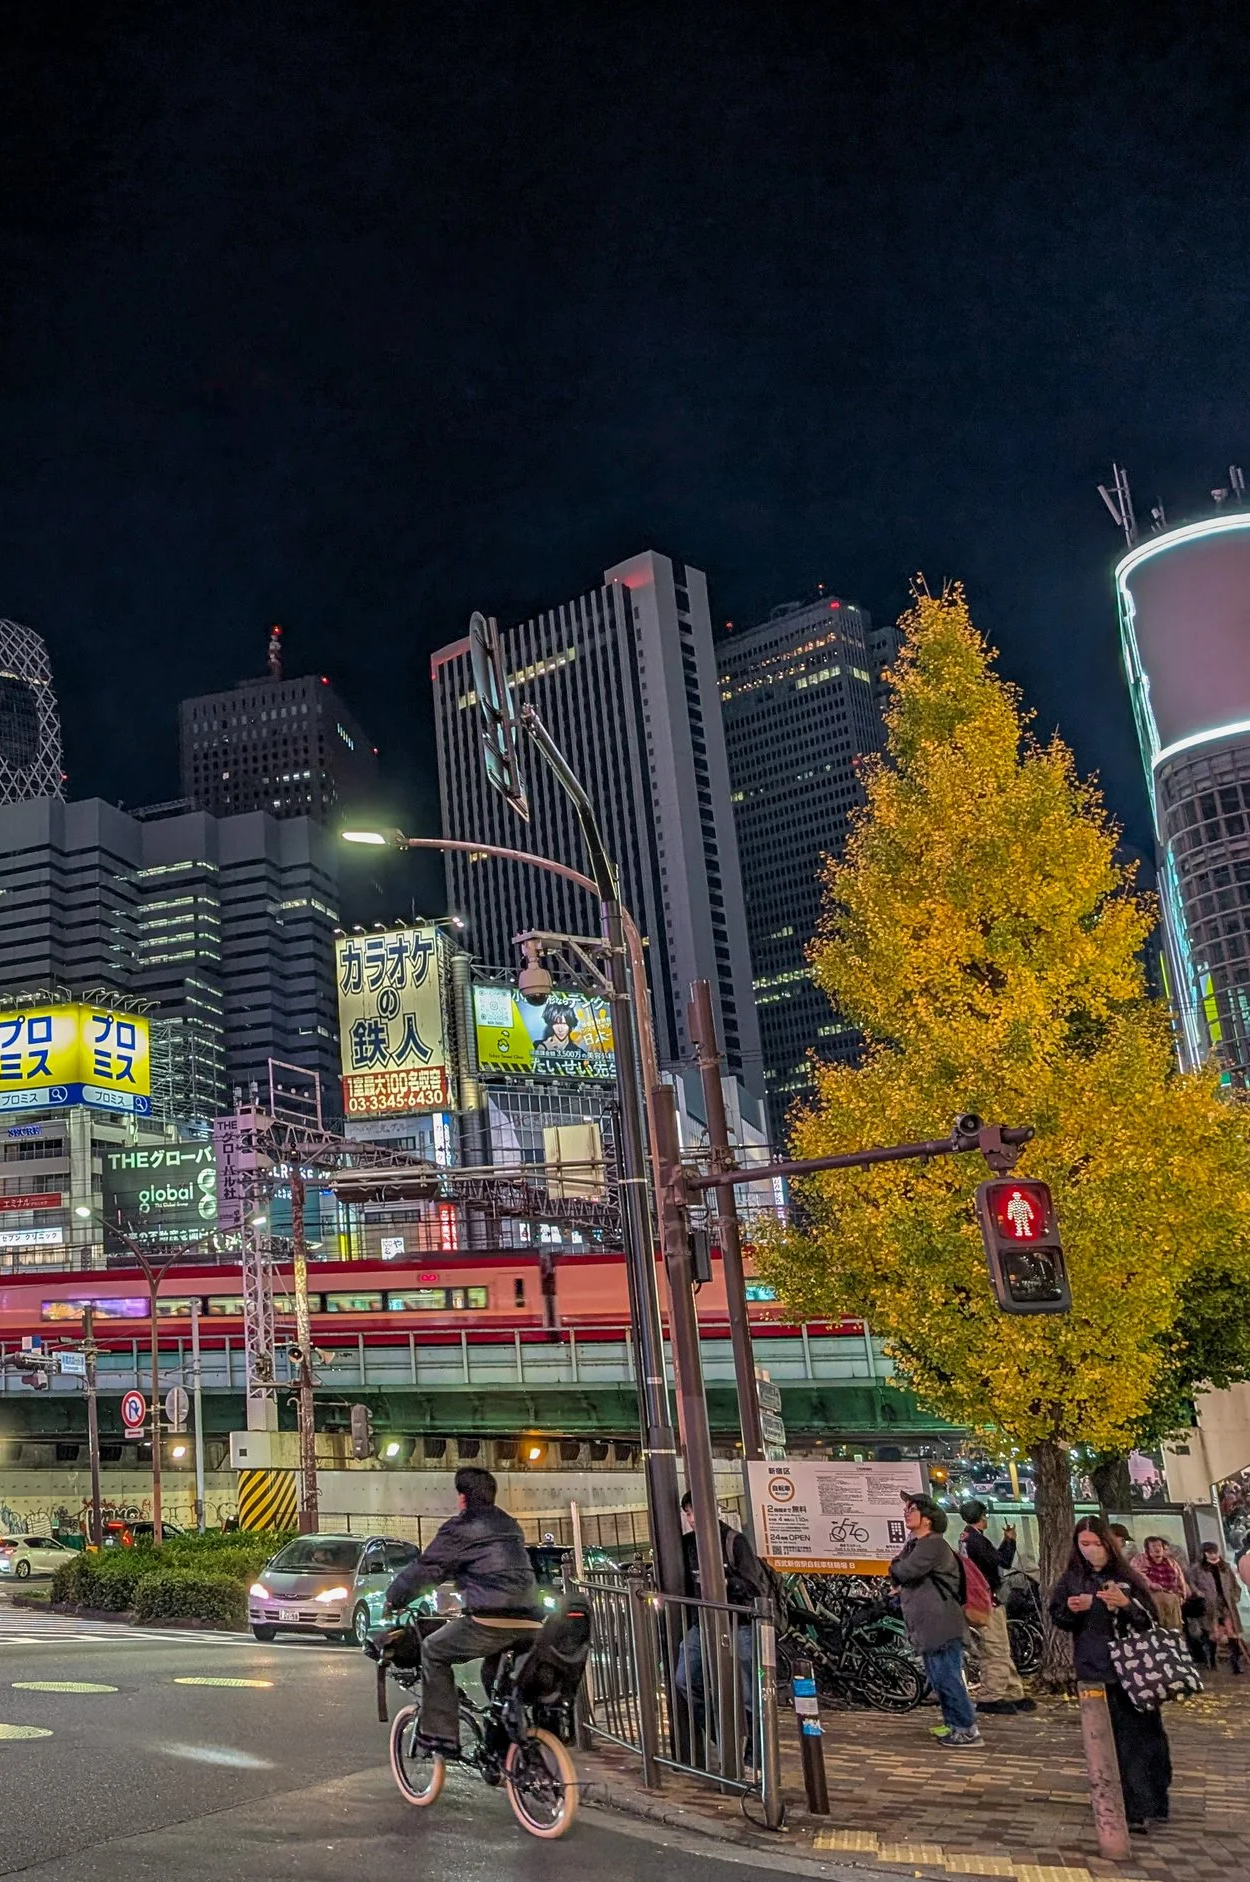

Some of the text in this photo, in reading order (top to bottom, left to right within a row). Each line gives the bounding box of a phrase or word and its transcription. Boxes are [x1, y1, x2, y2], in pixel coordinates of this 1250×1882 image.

[340, 931, 435, 997] カラオケ
[377, 985, 400, 1021] の
[0, 1015, 52, 1049] プロ
[92, 1015, 135, 1050] プロ
[349, 1012, 434, 1070] 鉄人
[0, 1049, 53, 1080] ミス
[94, 1049, 136, 1083] ミス
[2, 1093, 39, 1106] プロミス
[95, 1091, 125, 1105] プロミス
[217, 1122, 237, 1130] THE
[108, 1145, 217, 1170] THEグローバ
[139, 1182, 193, 1213] global
